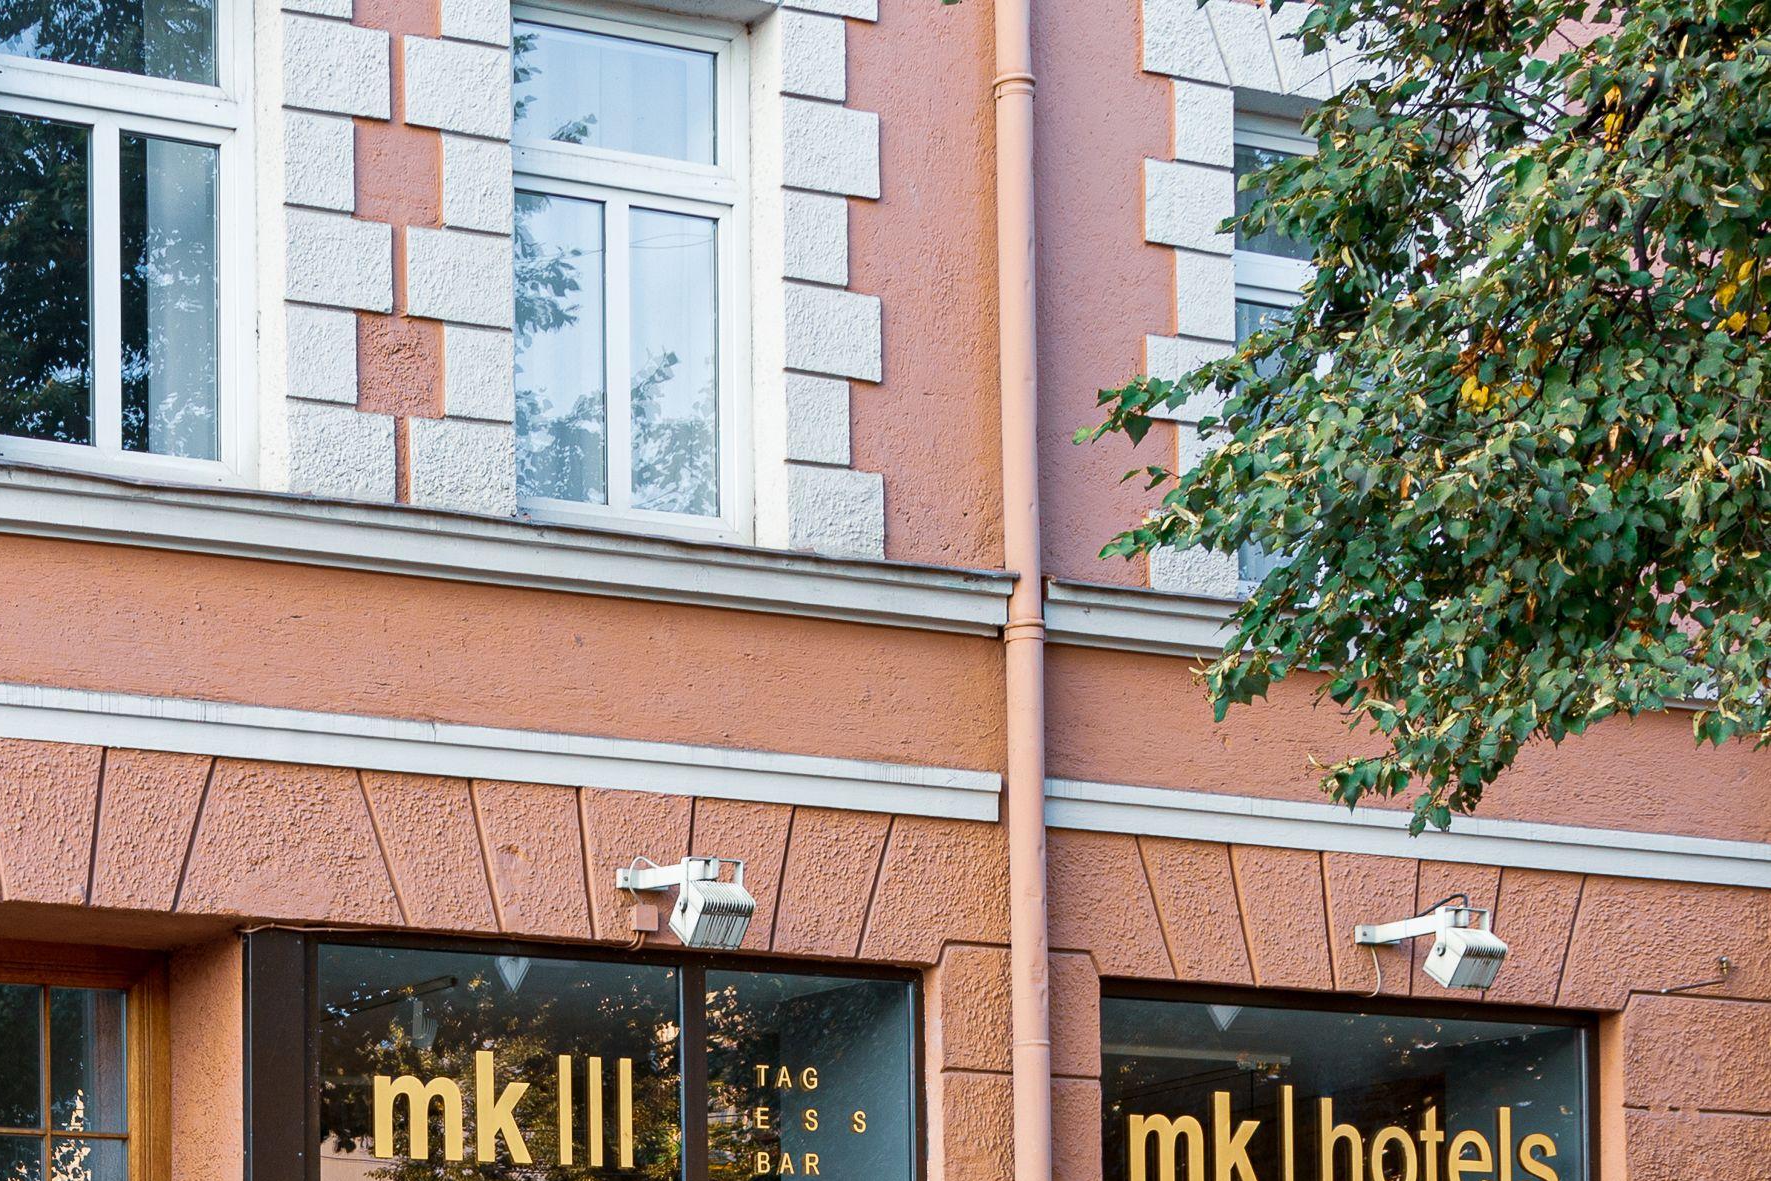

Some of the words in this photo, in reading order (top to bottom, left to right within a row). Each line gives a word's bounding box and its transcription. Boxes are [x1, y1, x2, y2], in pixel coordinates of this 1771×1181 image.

[755, 1064, 818, 1090] TAG
[372, 1050, 533, 1164] mk
[756, 1151, 820, 1176] BAR
